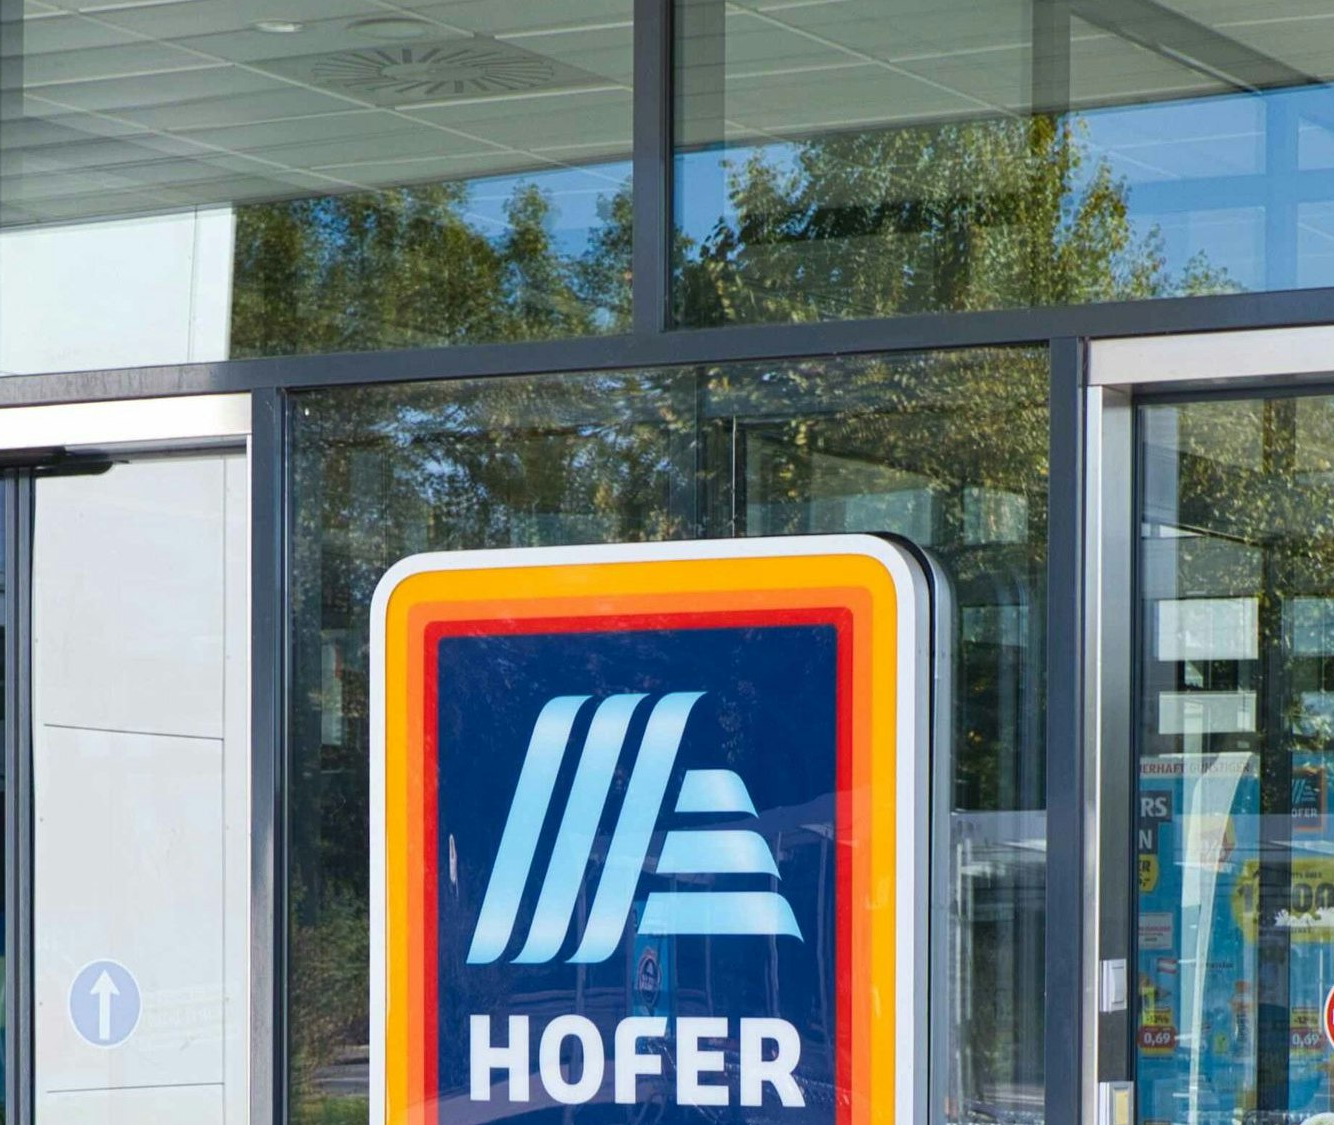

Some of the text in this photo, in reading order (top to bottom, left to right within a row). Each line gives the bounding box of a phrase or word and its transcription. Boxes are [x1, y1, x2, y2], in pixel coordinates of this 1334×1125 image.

[1291, 808, 1318, 818] OFER
[1144, 1032, 1171, 1045] 0,69
[1292, 1033, 1320, 1046] 0,69
[469, 1014, 805, 1108] HOFER
